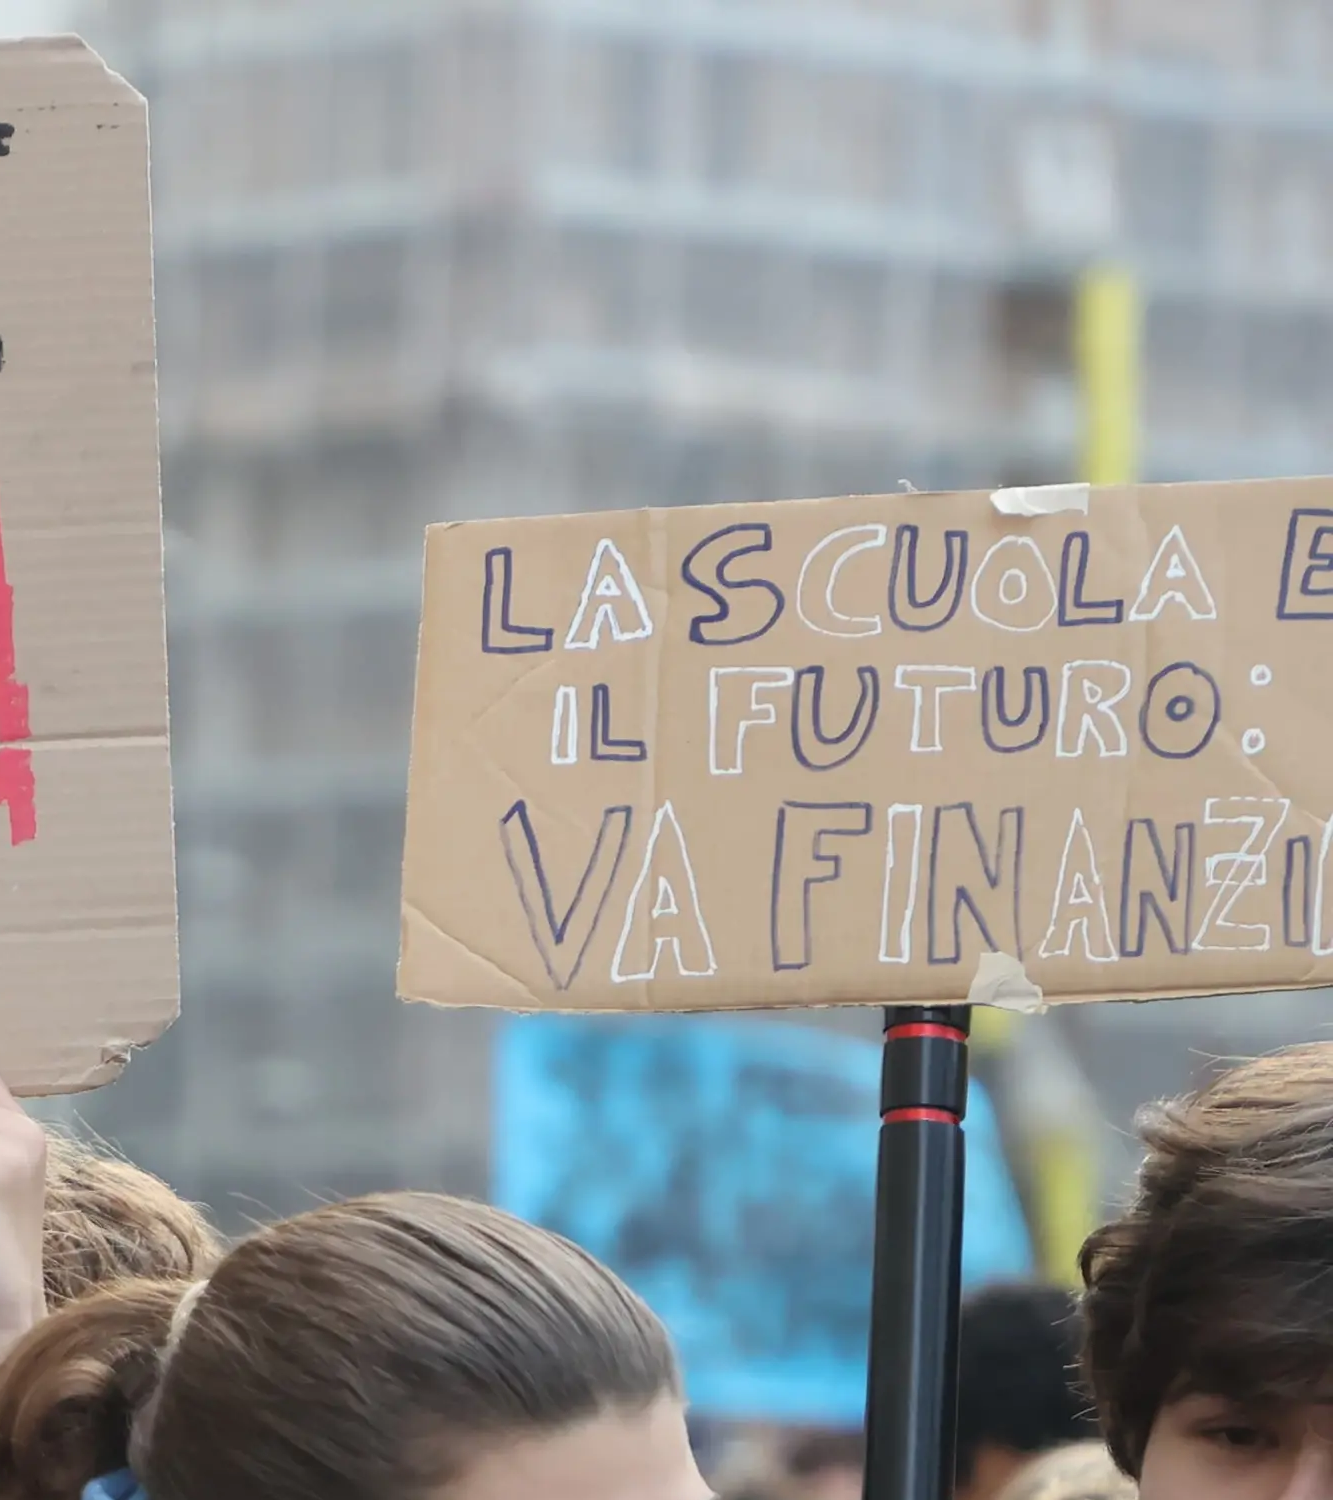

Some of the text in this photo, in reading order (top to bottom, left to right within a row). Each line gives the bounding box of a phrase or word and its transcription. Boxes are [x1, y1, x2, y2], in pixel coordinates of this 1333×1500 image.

[480, 537, 654, 655] LA
[680, 521, 1218, 646] SCUOLA
[549, 659, 1273, 776] IL FUTURO:
[499, 796, 1333, 991] VA FINANZI
